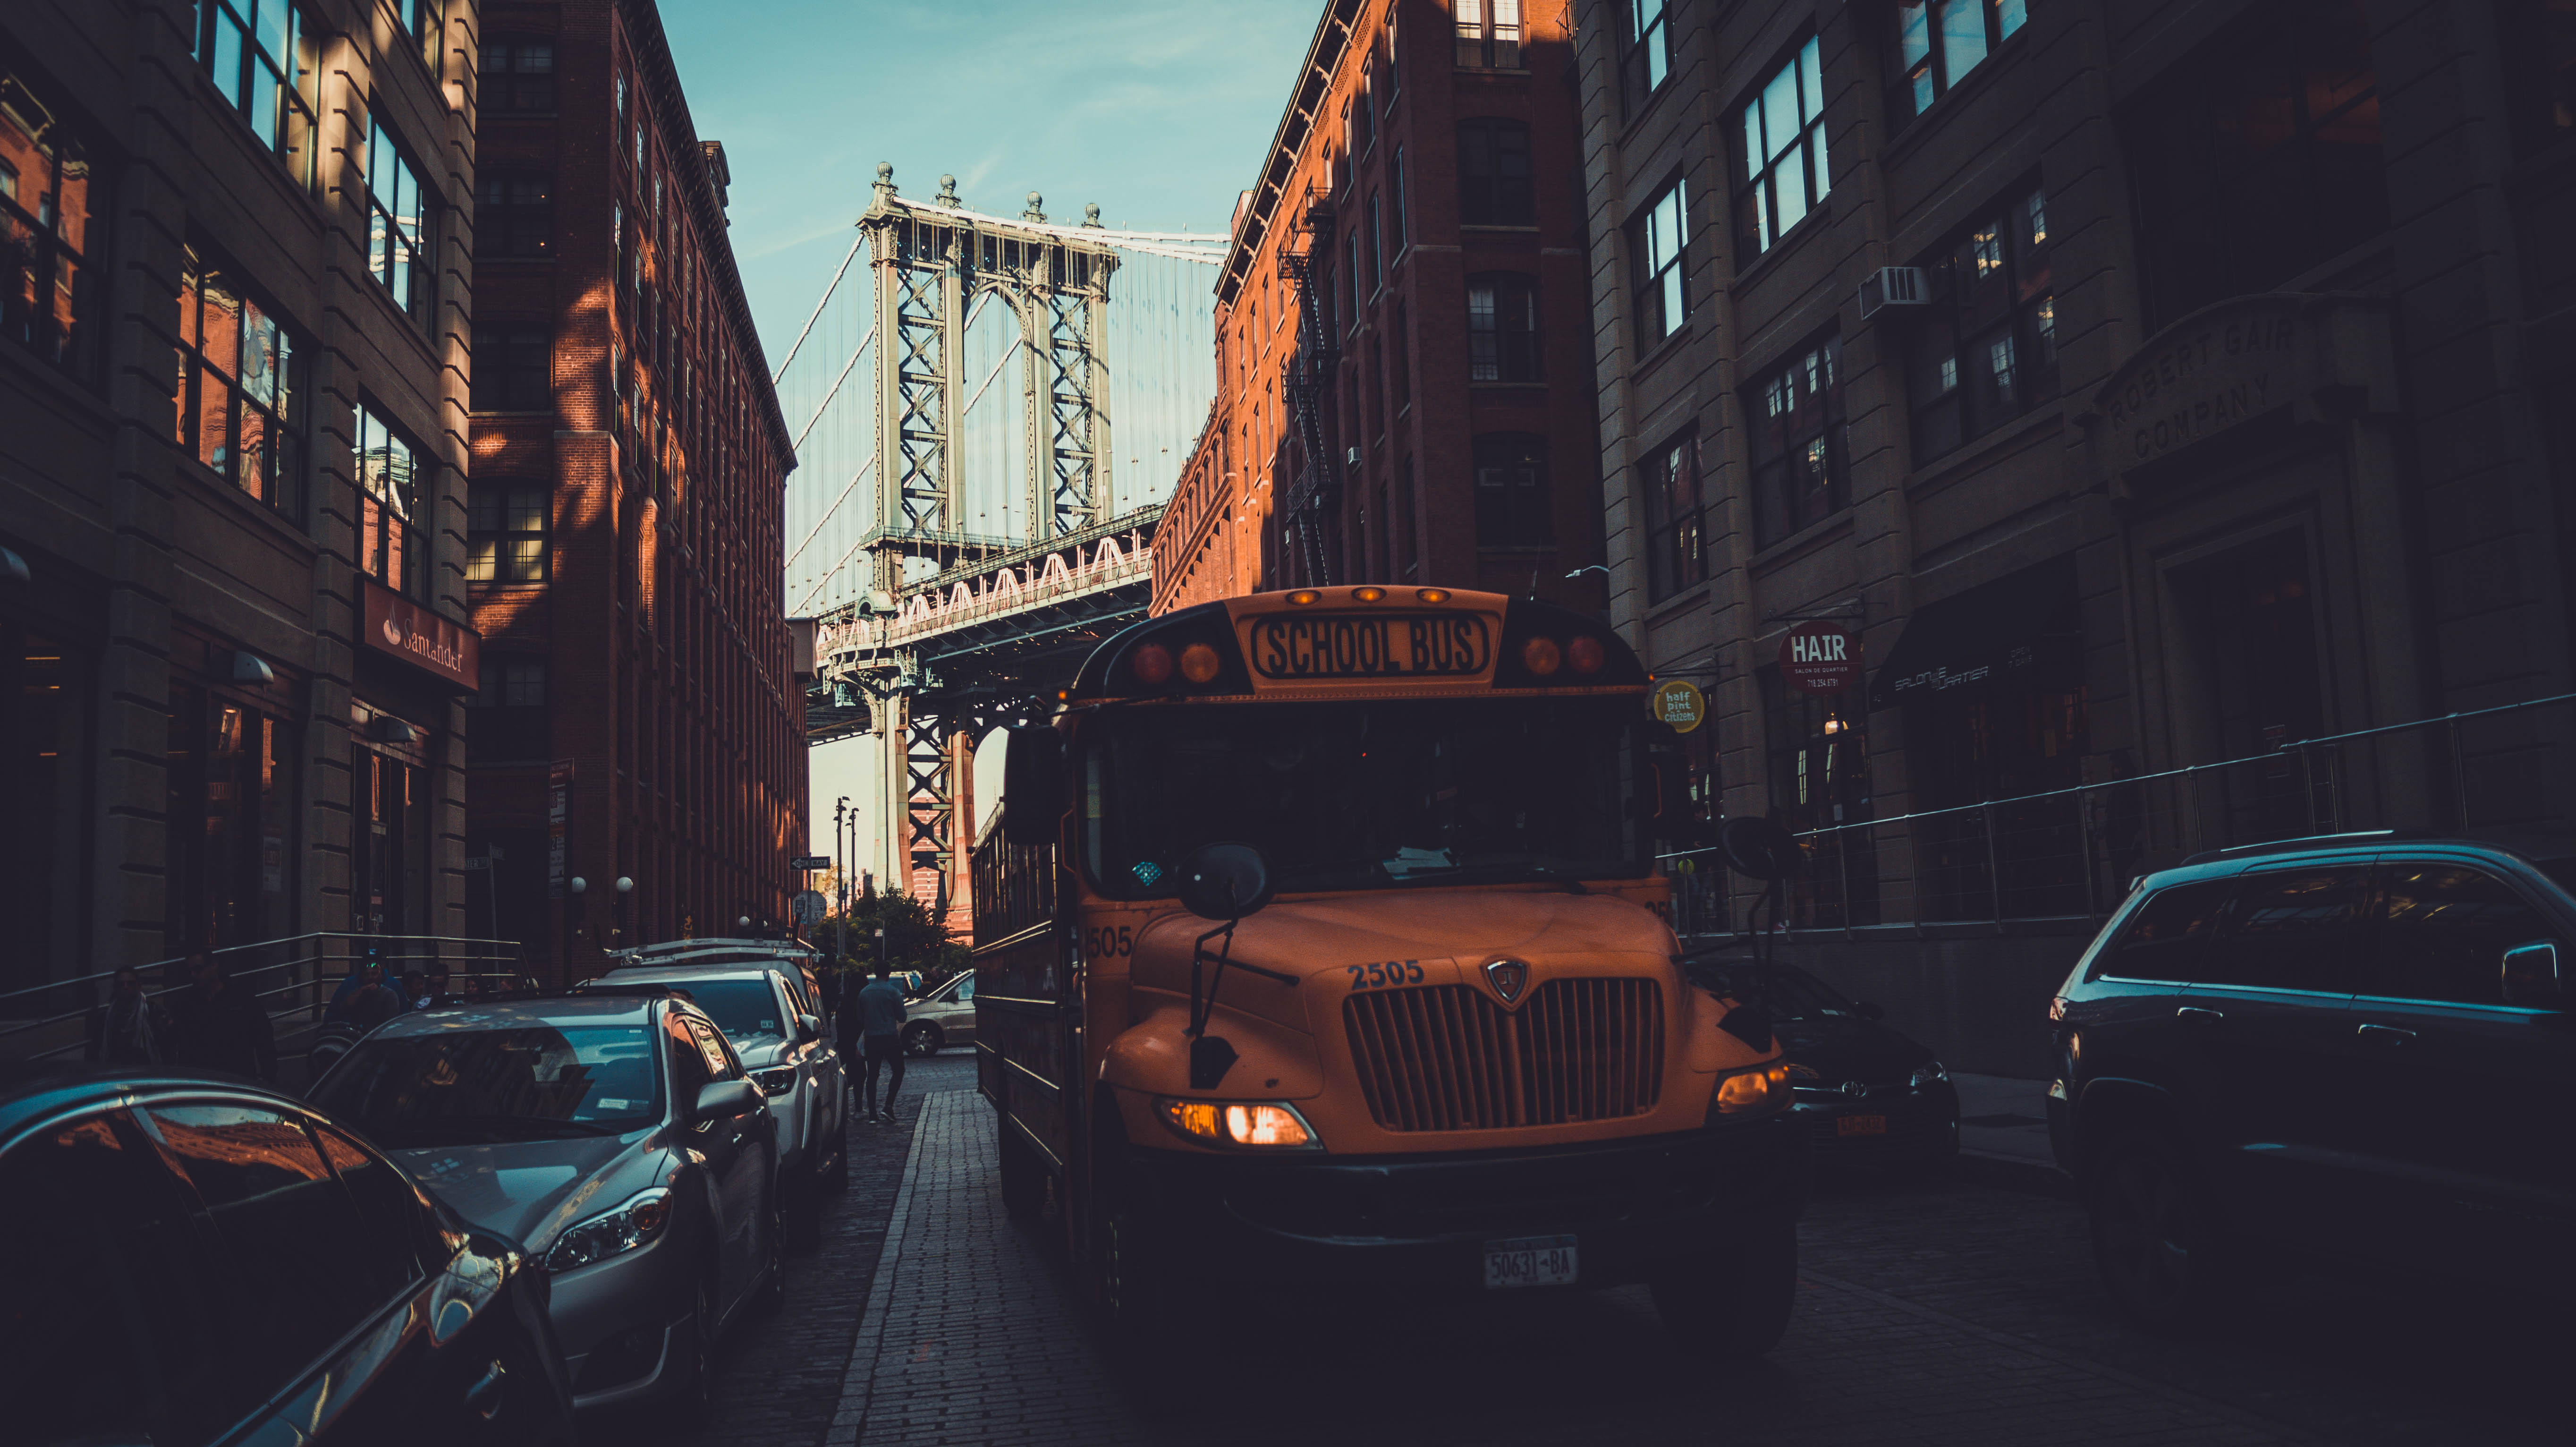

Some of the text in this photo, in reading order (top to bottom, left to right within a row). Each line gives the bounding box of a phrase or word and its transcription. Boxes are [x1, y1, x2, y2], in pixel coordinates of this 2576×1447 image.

[2110, 317, 2293, 432] ROBERT GAIR
[2134, 373, 2271, 460] COMPANY
[404, 618, 463, 672] Santander
[1266, 618, 1474, 674] SCHOOL BUS
[1791, 634, 1847, 662] HAIR
[2010, 646, 2031, 658] OPEN
[2016, 655, 2033, 667] DAYS
[1895, 671, 1931, 691] SALON
[1665, 691, 1691, 702] half
[1667, 701, 1691, 712] pint
[1664, 710, 1695, 722] citizens
[1086, 926, 1132, 958] 505
[1347, 959, 1424, 991] 2505
